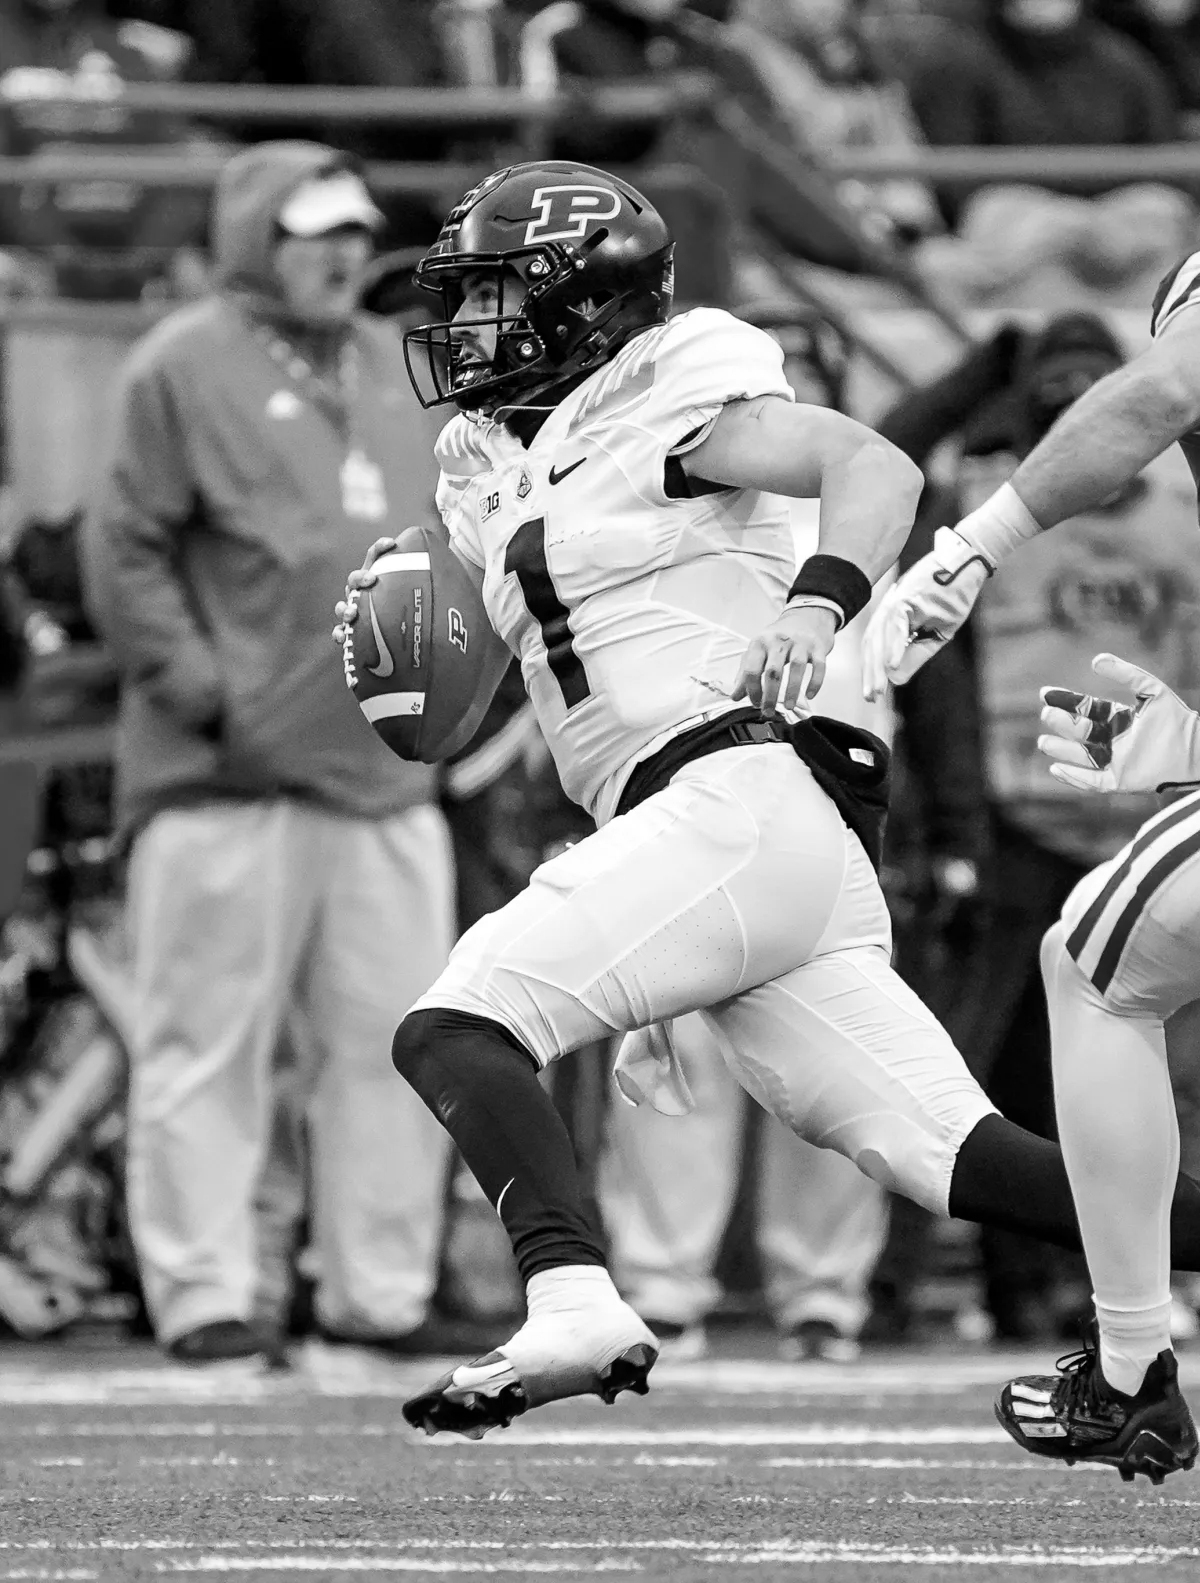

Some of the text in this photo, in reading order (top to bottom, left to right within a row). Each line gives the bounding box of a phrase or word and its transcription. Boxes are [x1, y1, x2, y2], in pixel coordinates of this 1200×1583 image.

[523, 184, 622, 246] P
[412, 587, 423, 669] VAPOR ELITE
[447, 606, 469, 656] P
[503, 513, 595, 713] 1
